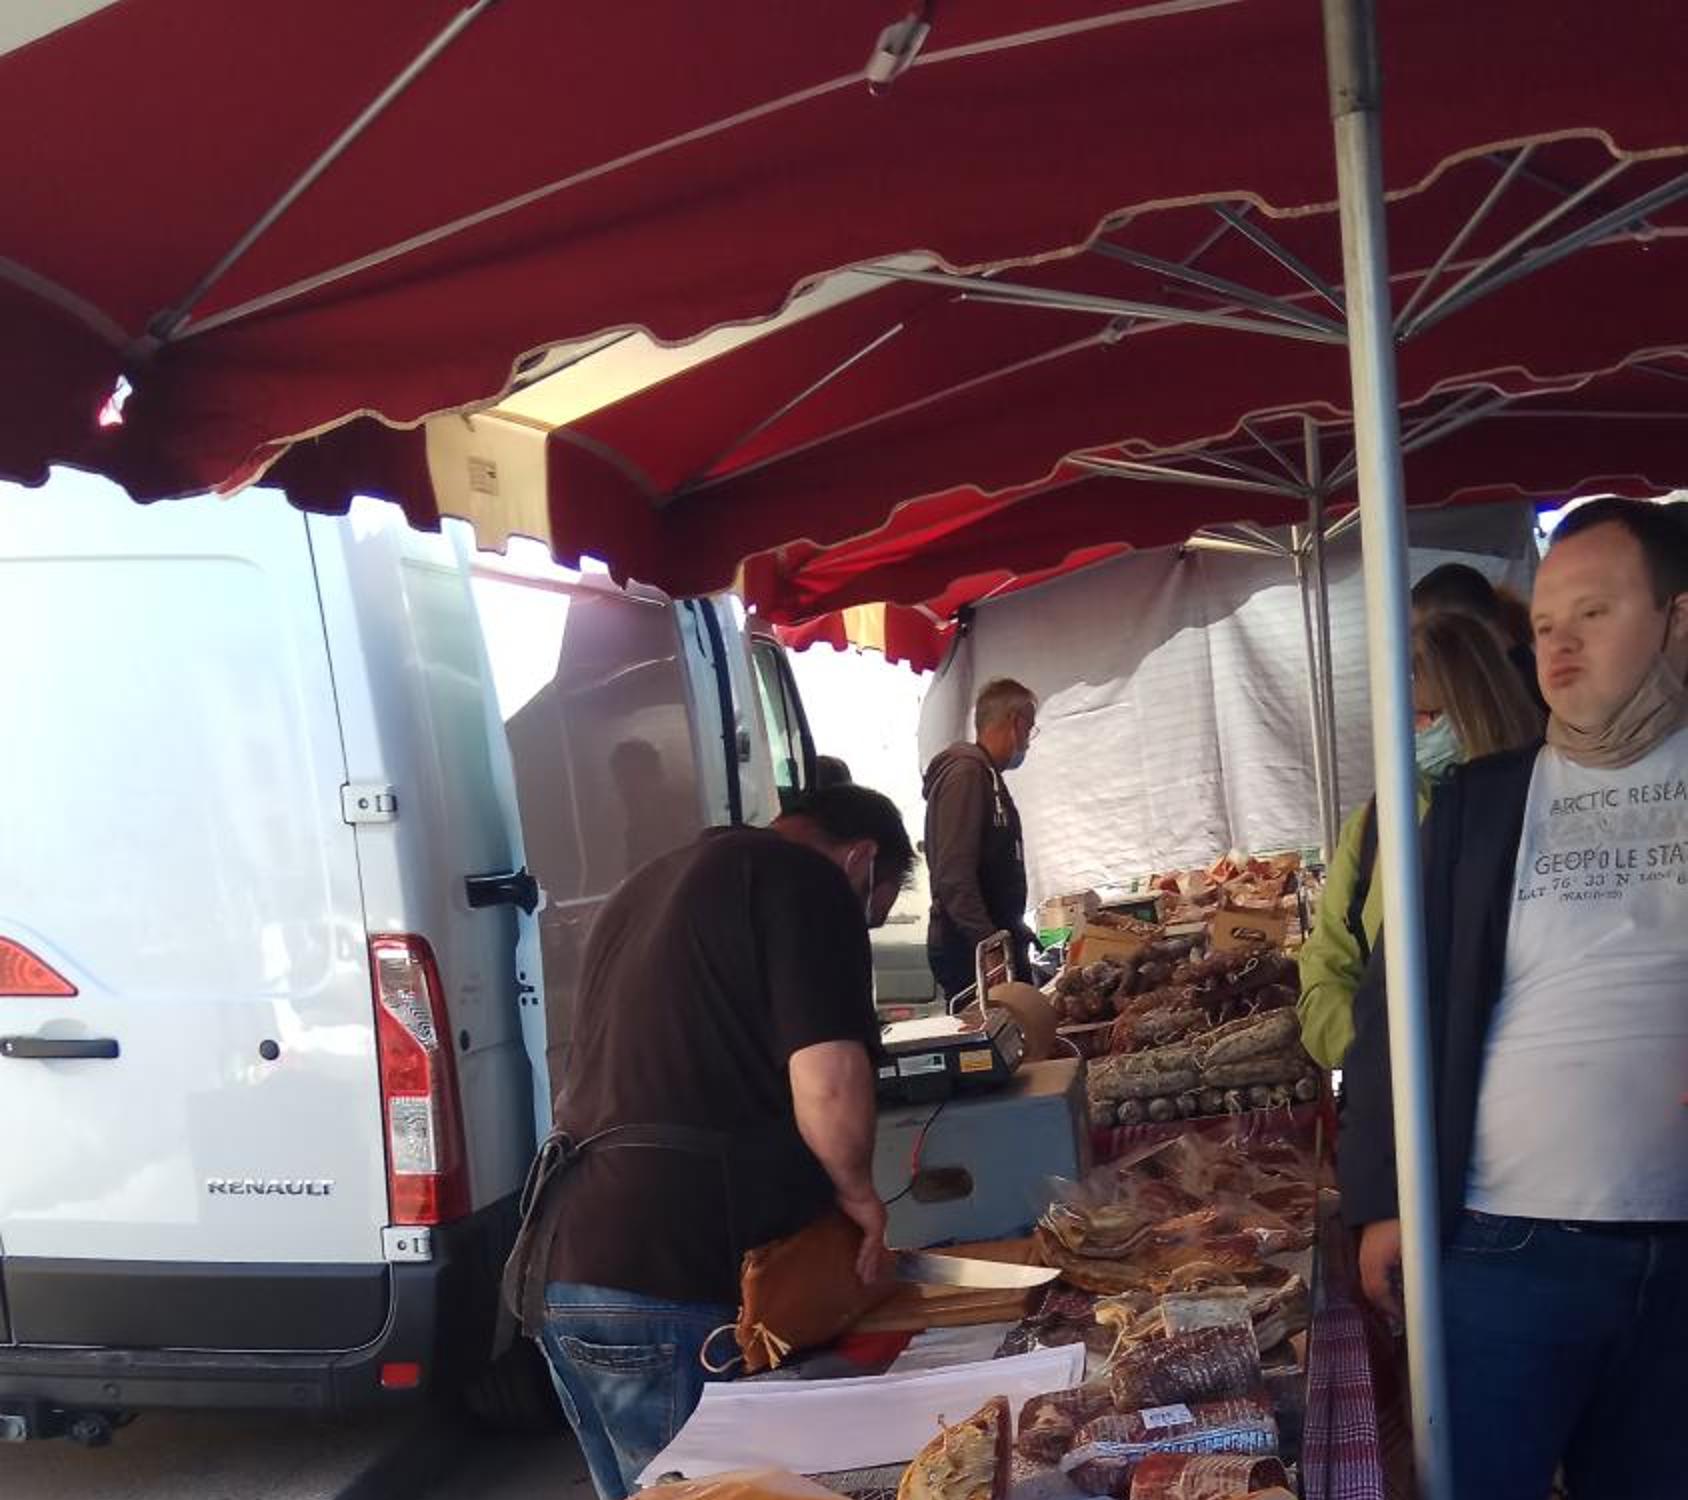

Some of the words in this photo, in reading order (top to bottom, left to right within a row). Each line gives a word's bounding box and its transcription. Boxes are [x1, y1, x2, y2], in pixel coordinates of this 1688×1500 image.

[1549, 789, 1619, 817] ARCTIC
[1629, 781, 1688, 804] RESEA
[1535, 849, 1638, 876] GEOPOLE
[207, 1179, 336, 1196] RENAULT
